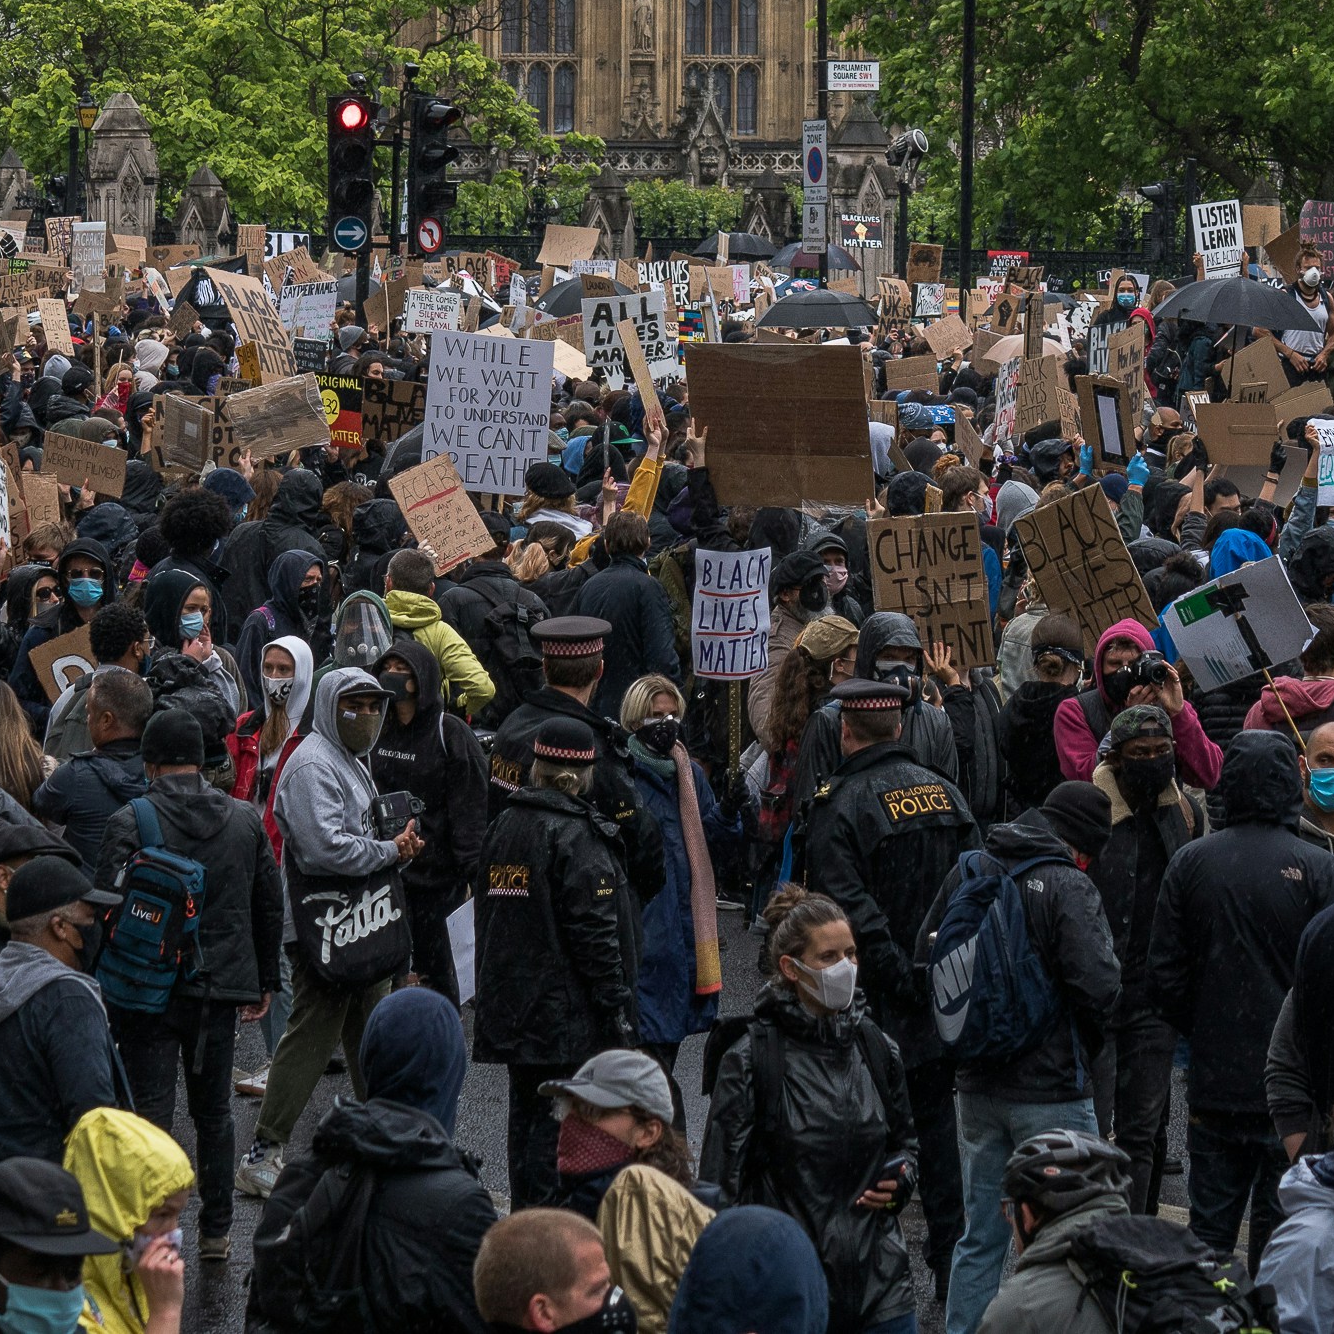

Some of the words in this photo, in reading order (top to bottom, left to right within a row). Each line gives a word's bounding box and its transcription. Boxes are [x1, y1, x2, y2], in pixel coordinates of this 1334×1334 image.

[807, 134, 822, 143] ZONE
[862, 215, 880, 223] LIVES
[1198, 203, 1237, 228] LISTEN
[843, 239, 882, 248] MATTER
[1201, 226, 1237, 251] LEARN
[82, 264, 102, 276] COME
[637, 262, 666, 284] BLACK
[666, 260, 689, 284] LIVES
[993, 259, 1022, 267] ANGRY
[35, 269, 64, 283] BLACK
[283, 286, 296, 299] SAY
[293, 283, 316, 297] THEIR
[316, 280, 339, 295] NAMES
[879, 279, 900, 296] The
[219, 282, 279, 320] BLACK
[411, 294, 433, 303] THERE
[436, 297, 457, 305] COMES
[437, 304, 454, 312] WHEN
[882, 295, 902, 317] UK
[419, 310, 447, 319] SILENCE
[590, 296, 658, 328] ALL
[238, 310, 287, 349] LIVES
[415, 320, 452, 330] BETRAYAL
[444, 337, 532, 367] WHILE
[315, 375, 362, 390] ORIGINAL
[435, 364, 468, 384] WE
[481, 368, 540, 390] WAIT
[449, 386, 480, 406] FOR
[487, 389, 522, 408] YOU
[431, 404, 457, 420] TO
[463, 407, 548, 427] UNDERSTAND
[49, 433, 73, 451] HOW
[75, 440, 101, 457] MANY
[430, 422, 470, 449] WE
[86, 462, 121, 479] FILMED?
[400, 461, 456, 508] ACAB
[411, 511, 429, 526] YOU
[418, 513, 451, 535] BELIEVE
[457, 514, 470, 524] BUT
[455, 529, 469, 539] FOR
[1019, 490, 1111, 573] BLACK
[875, 524, 977, 575] CHANGE
[702, 554, 769, 593] BLACK
[1054, 537, 1135, 600] LIVES
[892, 572, 978, 618] ISN'T
[699, 633, 768, 673] MATTER
[491, 760, 521, 785] POLICE
[884, 789, 905, 802] CITY
[909, 785, 944, 796] LONDON
[888, 794, 951, 820] POLICE
[490, 872, 528, 888] POLICE
[301, 883, 402, 964] Patta
